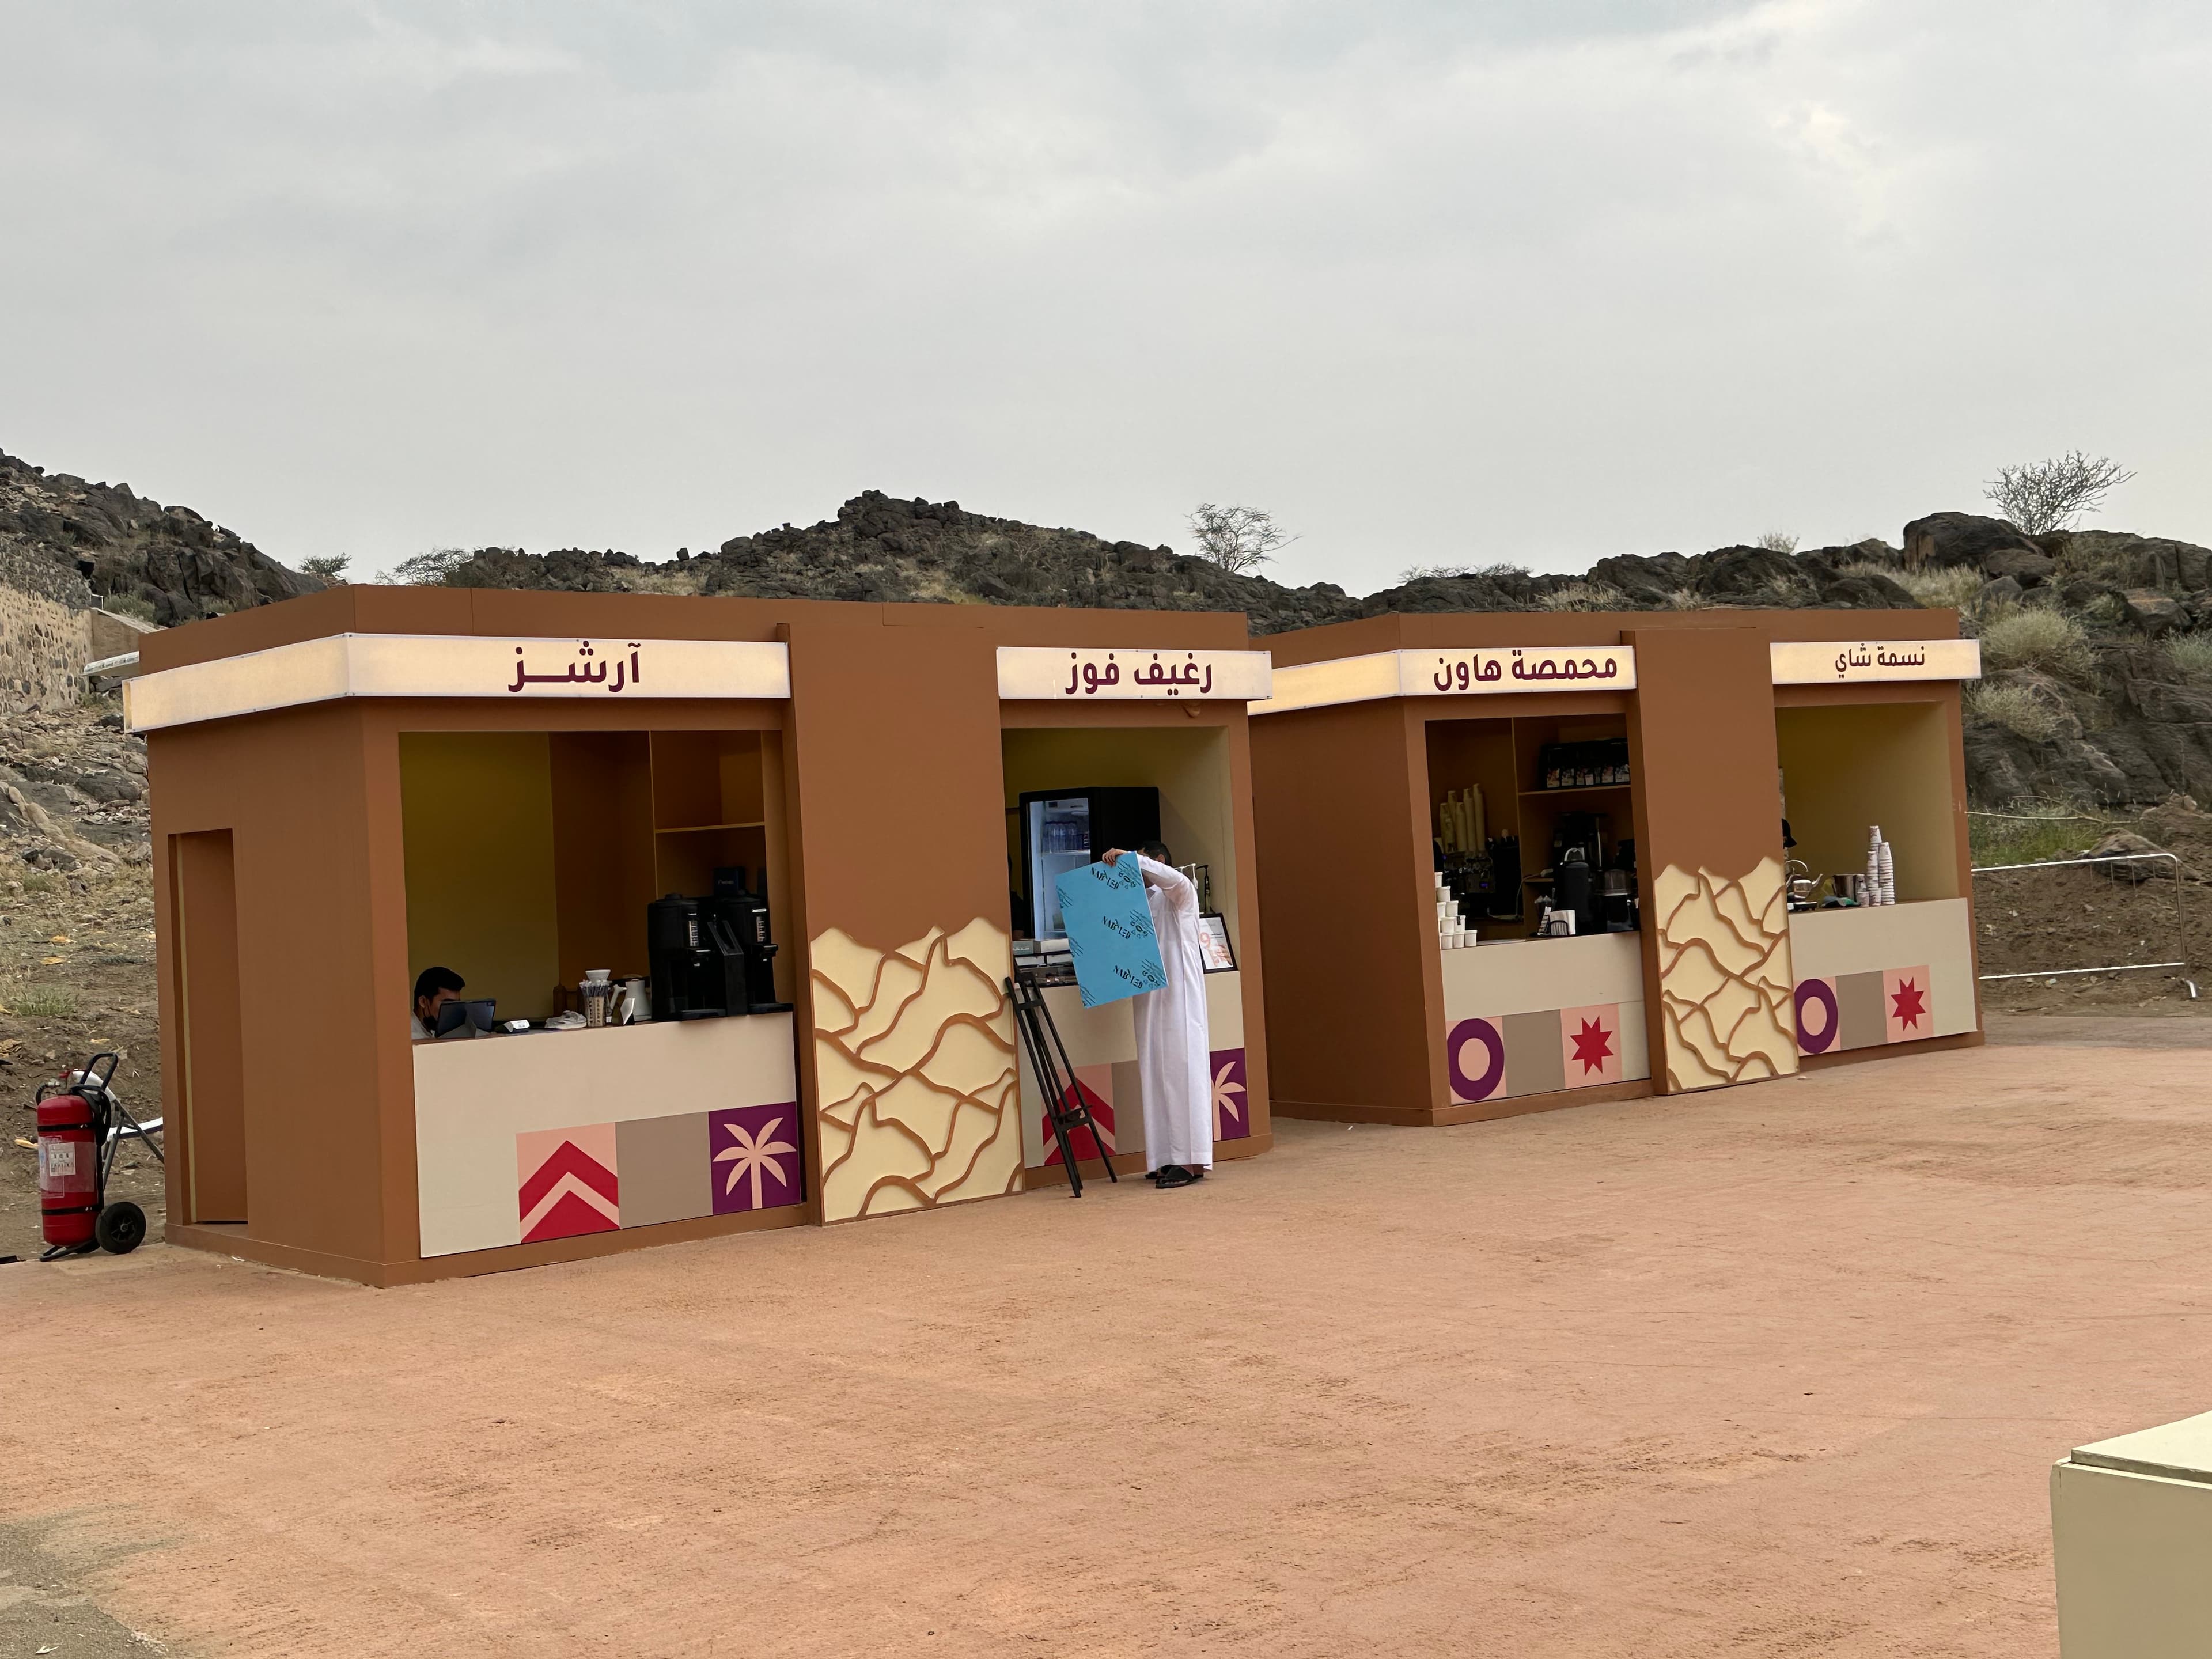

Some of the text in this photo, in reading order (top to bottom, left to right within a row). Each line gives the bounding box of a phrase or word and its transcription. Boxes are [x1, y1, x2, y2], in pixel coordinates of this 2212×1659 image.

[1065, 652, 1212, 696] رغيف فوز
[1434, 649, 1618, 692] محمصة هاون
[1835, 643, 1925, 679] نسمة شاي
